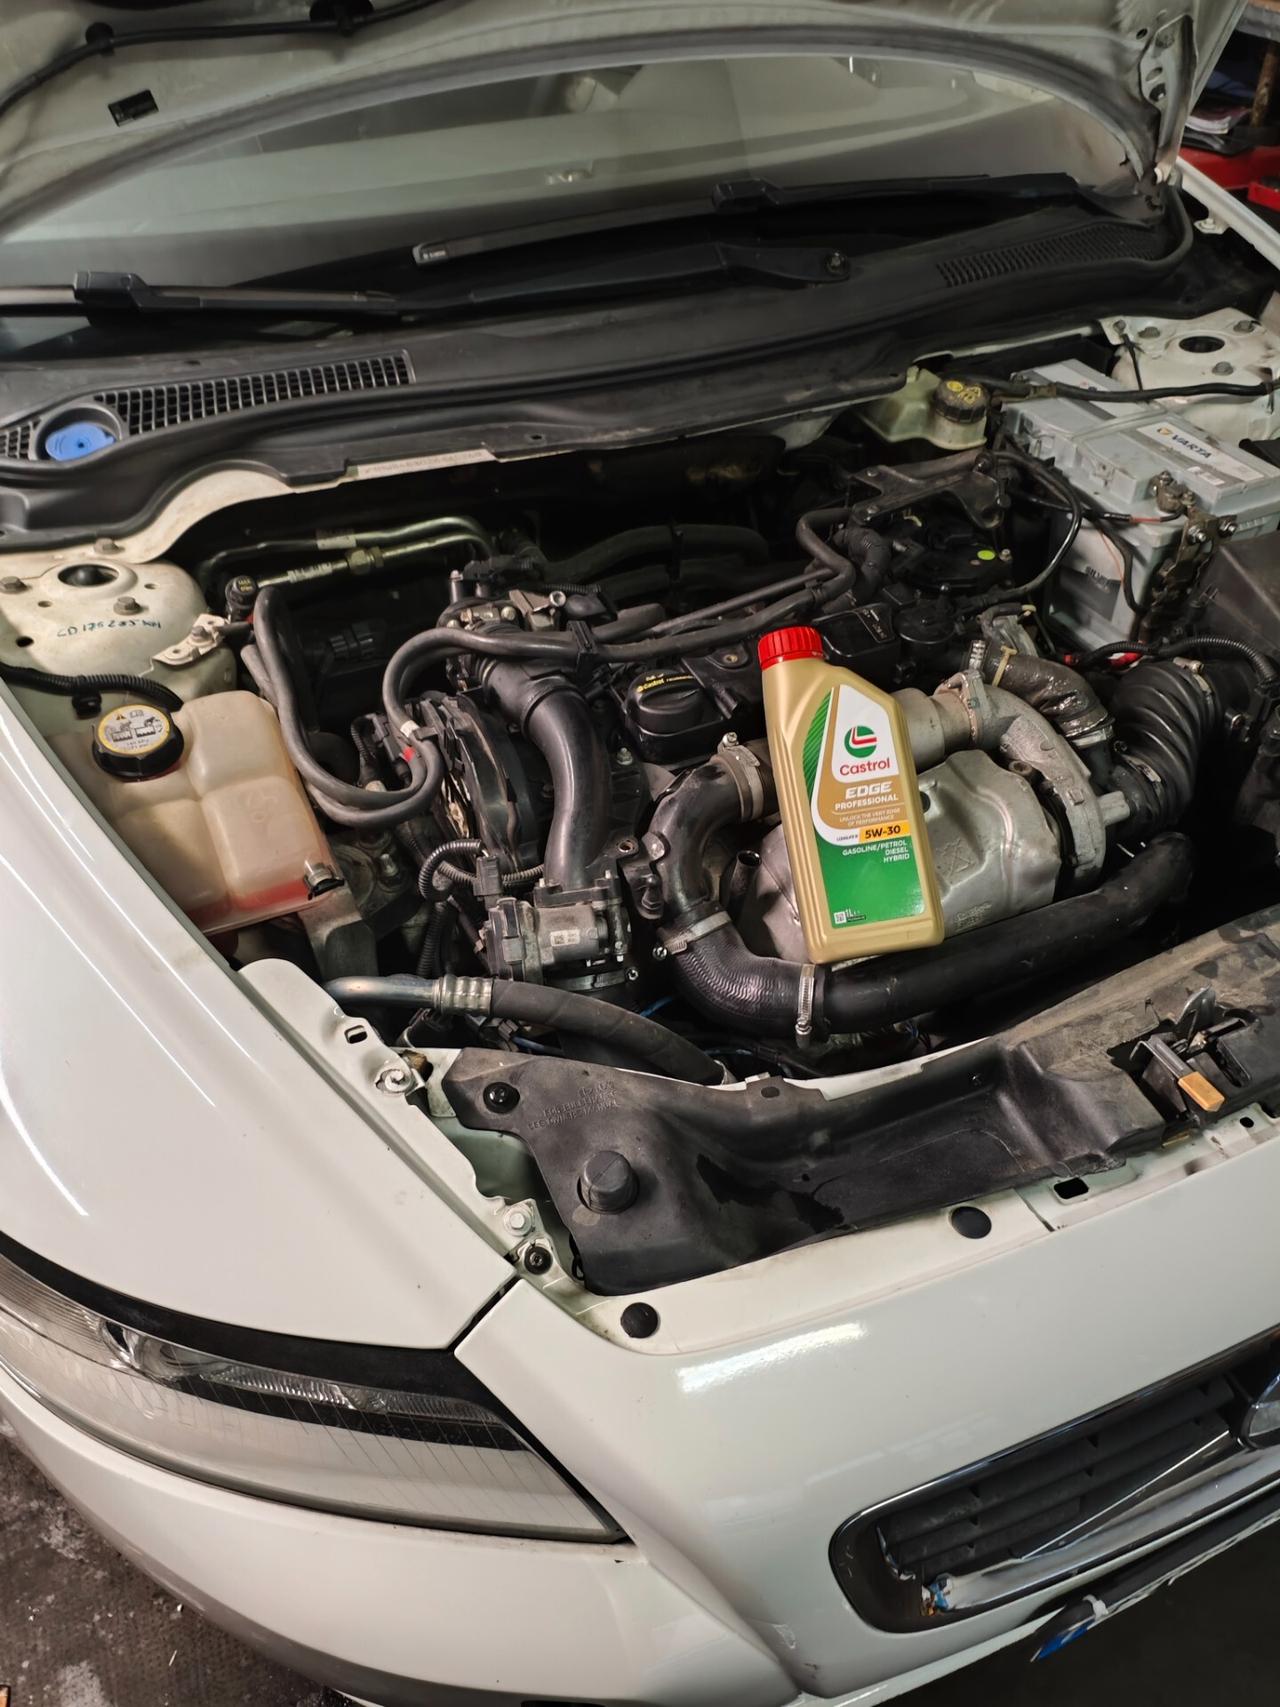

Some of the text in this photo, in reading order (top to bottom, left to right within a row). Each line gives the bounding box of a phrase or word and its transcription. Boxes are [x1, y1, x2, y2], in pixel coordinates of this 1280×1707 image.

[1172, 434, 1212, 458] VARTA
[840, 758, 890, 776] Castrol
[845, 781, 893, 800] EDGE
[835, 794, 898, 811] PROFESSIONAL
[865, 825, 902, 840] 5W-30
[842, 839, 908, 856] GASOLINE/PETROL
[884, 847, 909, 856] DIESEL
[883, 853, 910, 863] HYBRID
